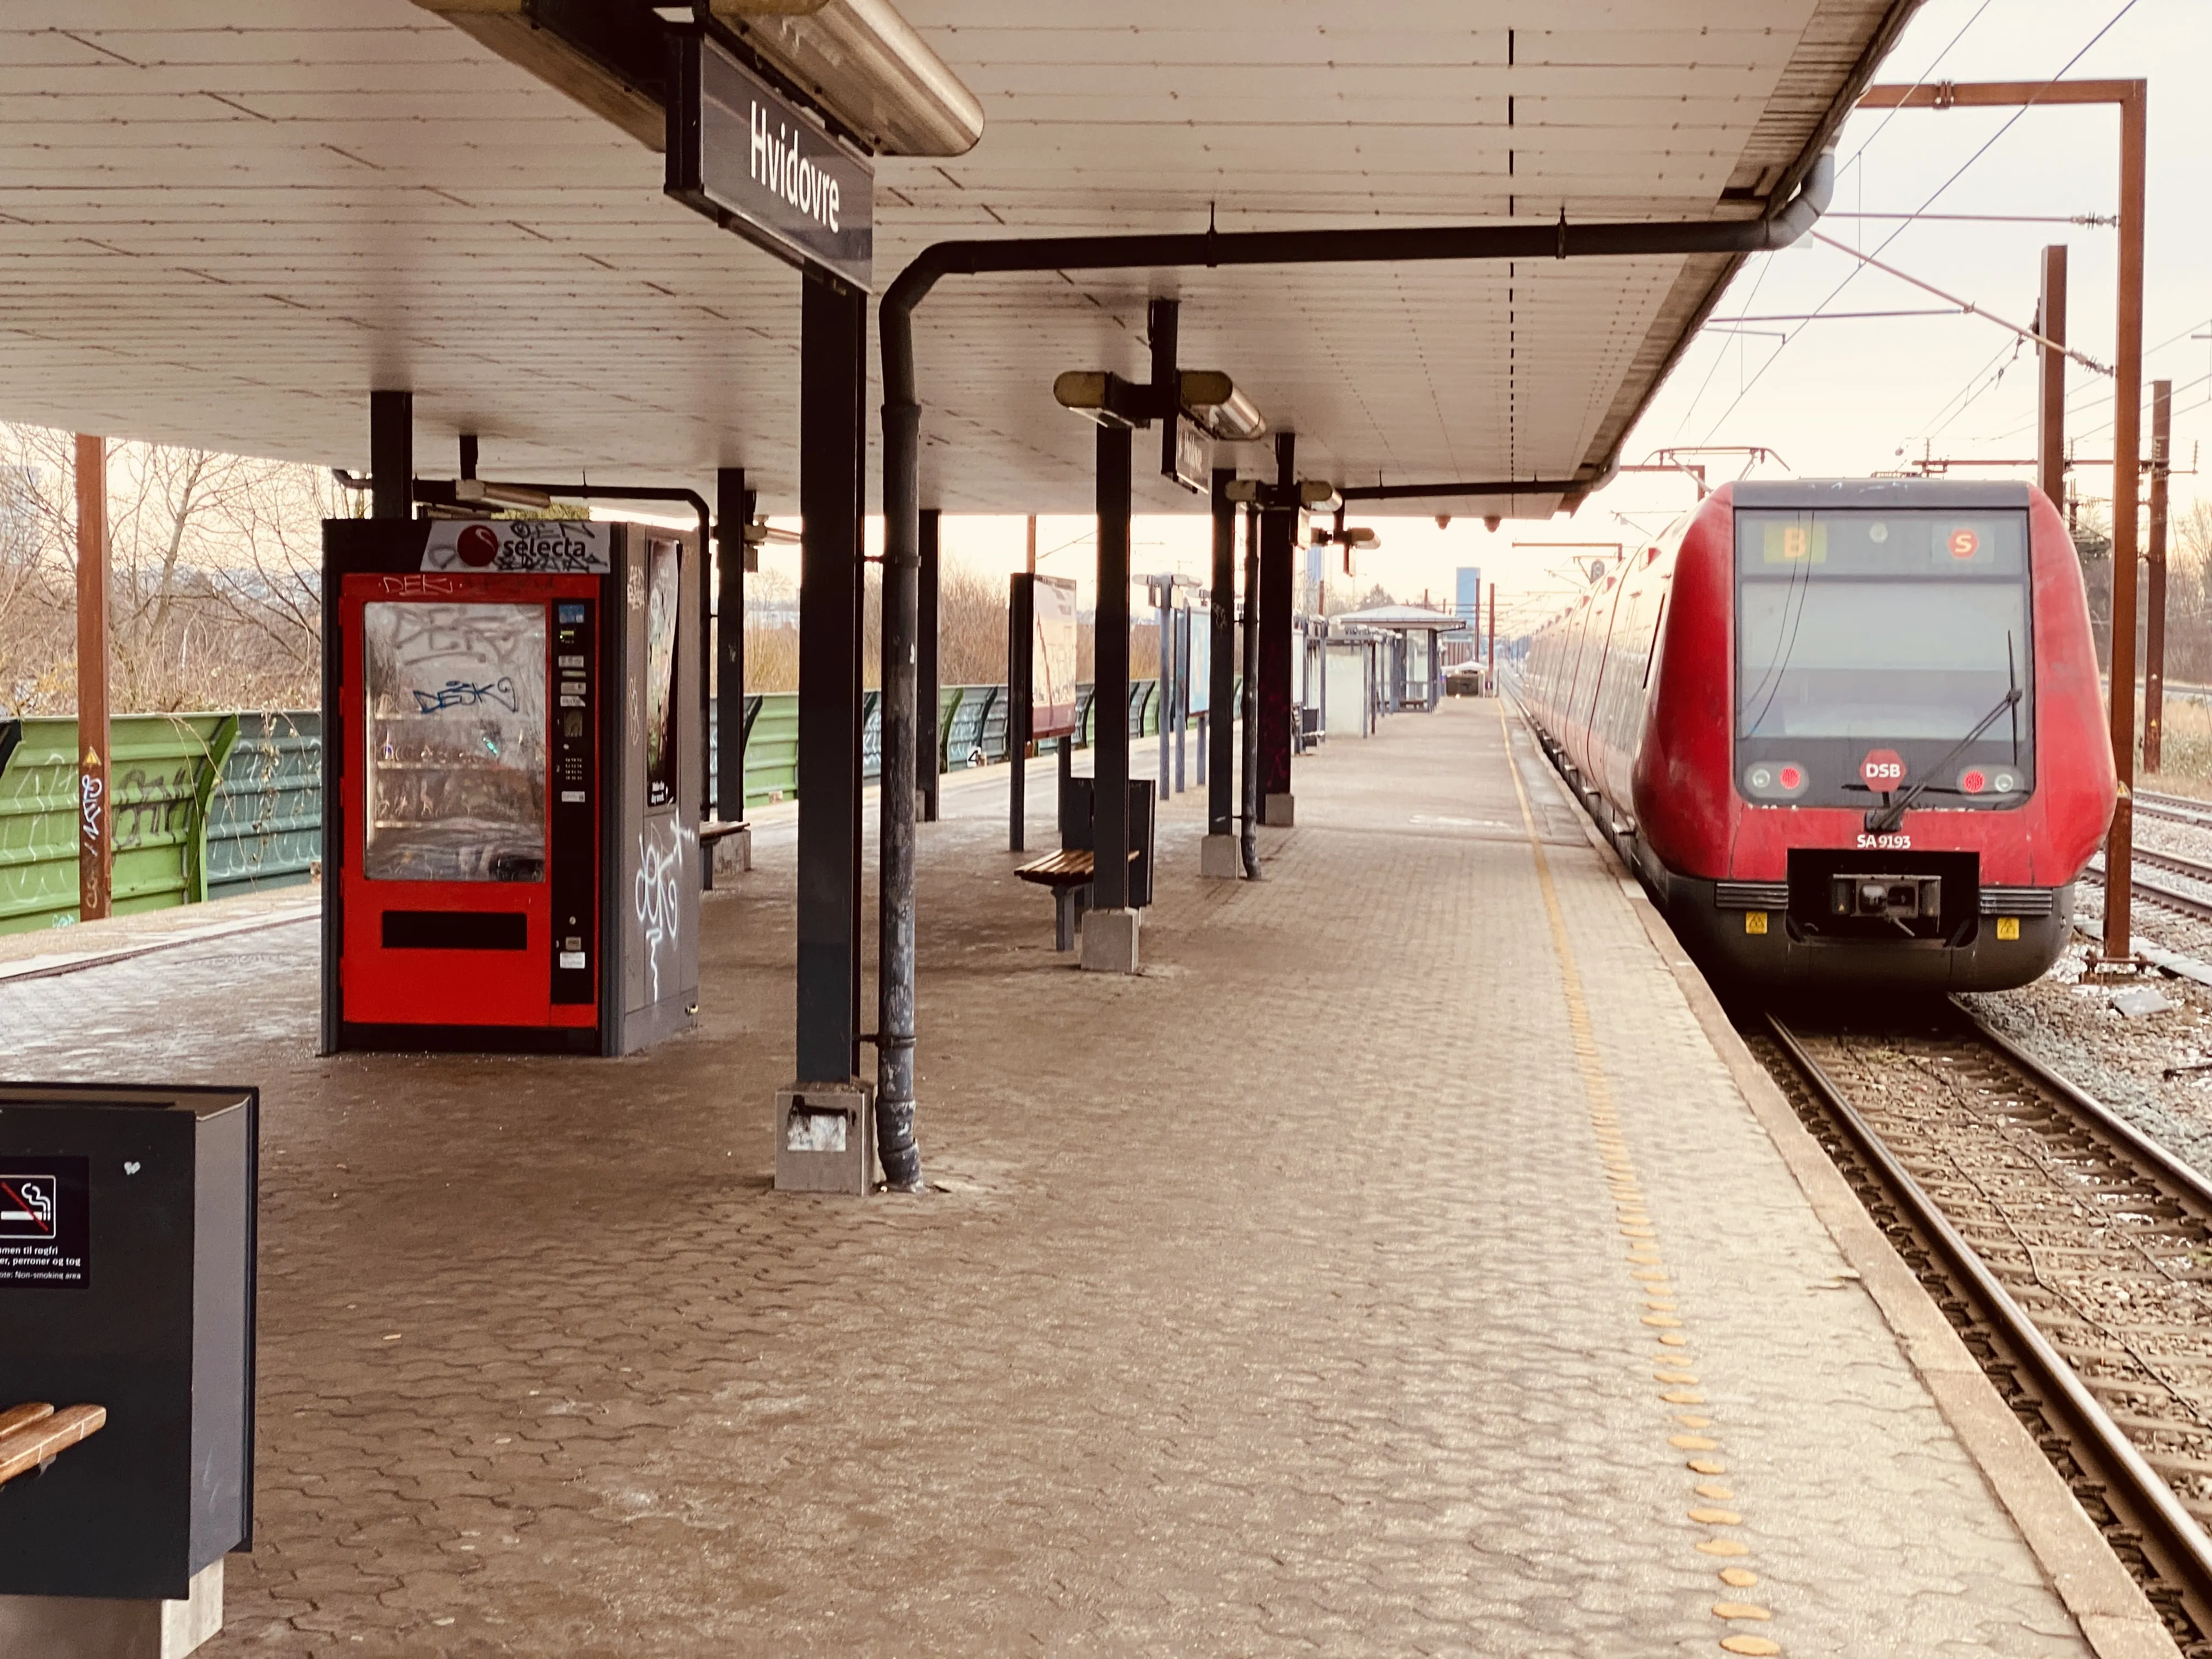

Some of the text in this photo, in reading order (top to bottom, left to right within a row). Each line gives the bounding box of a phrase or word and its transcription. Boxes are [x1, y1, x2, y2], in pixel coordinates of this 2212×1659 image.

[751, 100, 839, 234] Hvidovre
[503, 537, 586, 557] selecta
[1784, 527, 1805, 558] B
[1954, 534, 1972, 553] S
[1866, 763, 1901, 778] DSB
[1857, 833, 1911, 850] SA 9193
[24, 1245, 32, 1255] til
[34, 1245, 58, 1256] røgfri
[13, 1257, 50, 1267] perroner
[52, 1257, 64, 1267] og
[66, 1257, 81, 1267] tog
[15, 1270, 64, 1280] Non-smoking
